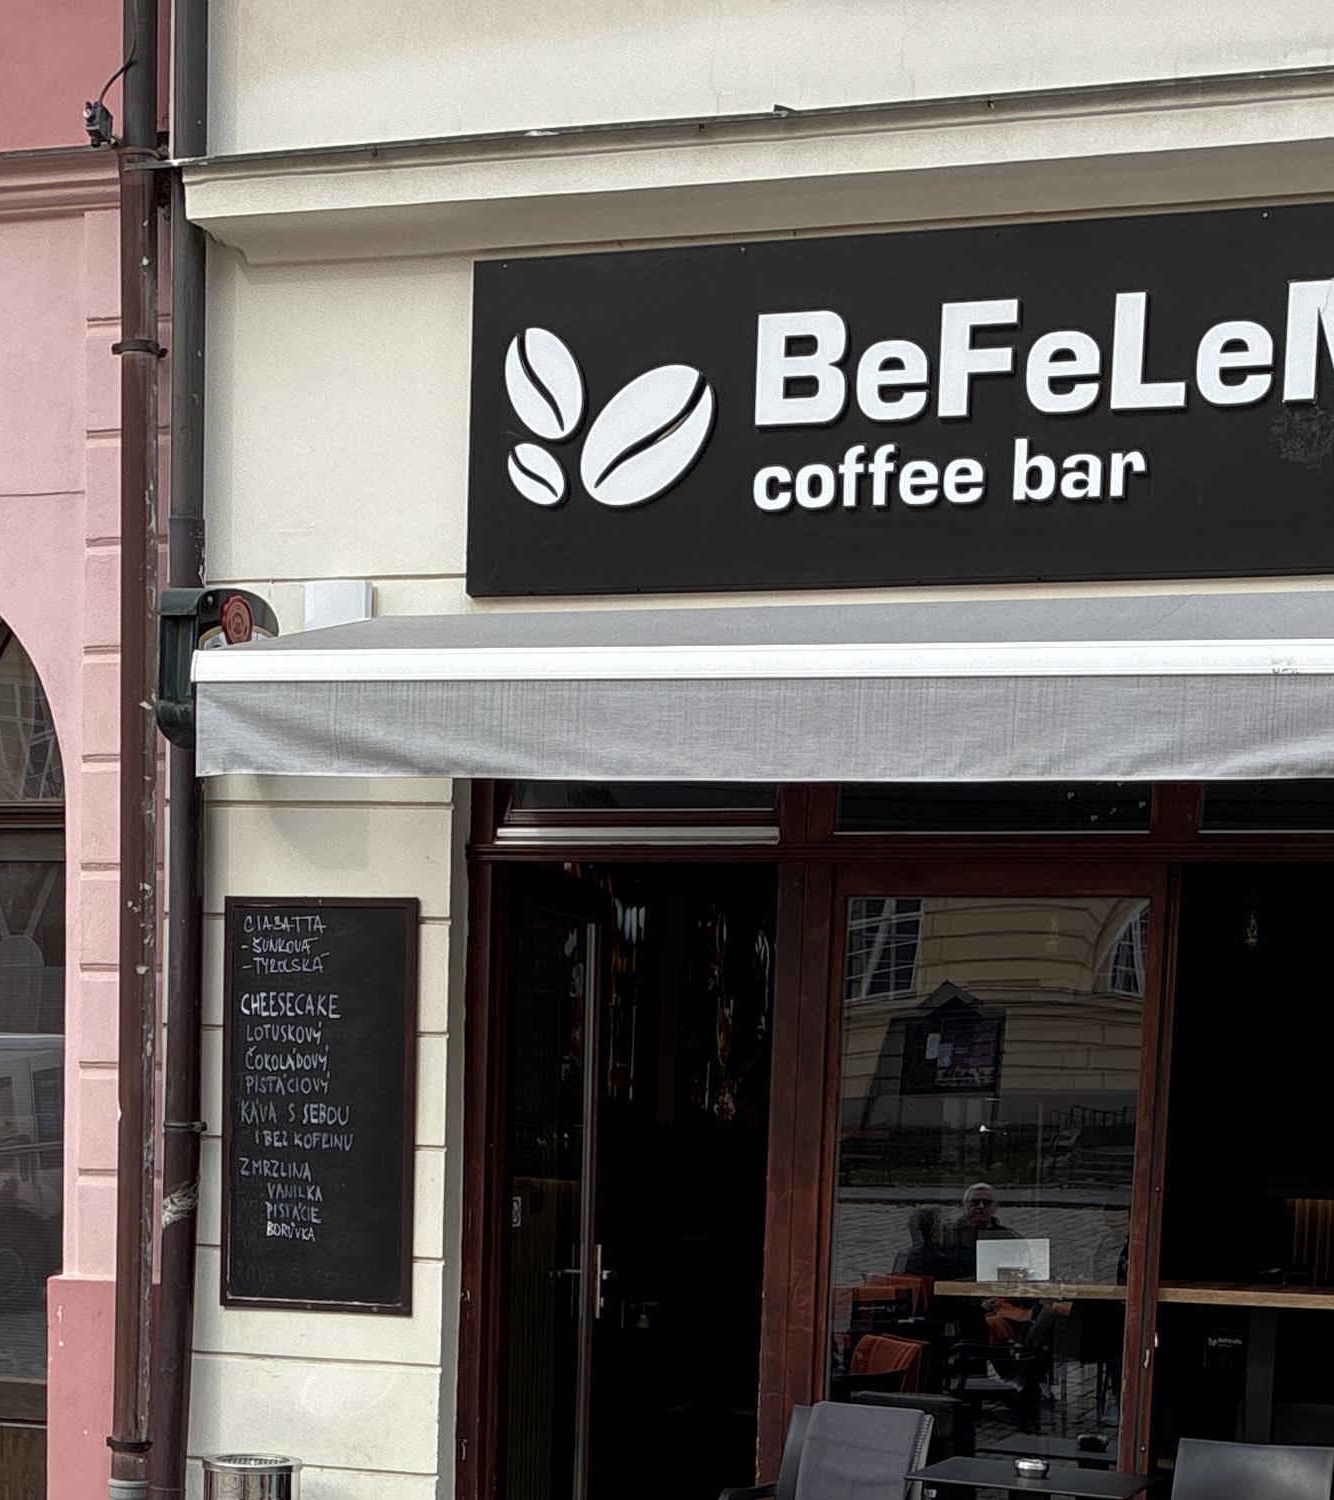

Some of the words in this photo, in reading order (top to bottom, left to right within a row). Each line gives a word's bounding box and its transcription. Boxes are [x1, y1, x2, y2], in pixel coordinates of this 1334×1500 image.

[753, 444, 986, 513] coffee
[1013, 438, 1147, 502] bar
[244, 915, 327, 934] CIABATTA
[241, 991, 342, 1019] CHEESECAKE
[247, 1020, 322, 1045] LOTUSKOVÝ
[245, 1045, 329, 1072] ČOKOLÁDOVÝ
[241, 1099, 277, 1125] KÁVA
[288, 1102, 296, 1122] S
[263, 1130, 288, 1148] BEZ
[293, 1131, 354, 1151] KOFEINU
[239, 1157, 312, 1182] ZMRZLINA
[267, 1182, 323, 1202] VANILKA
[265, 1201, 322, 1224] PISTÁCIE
